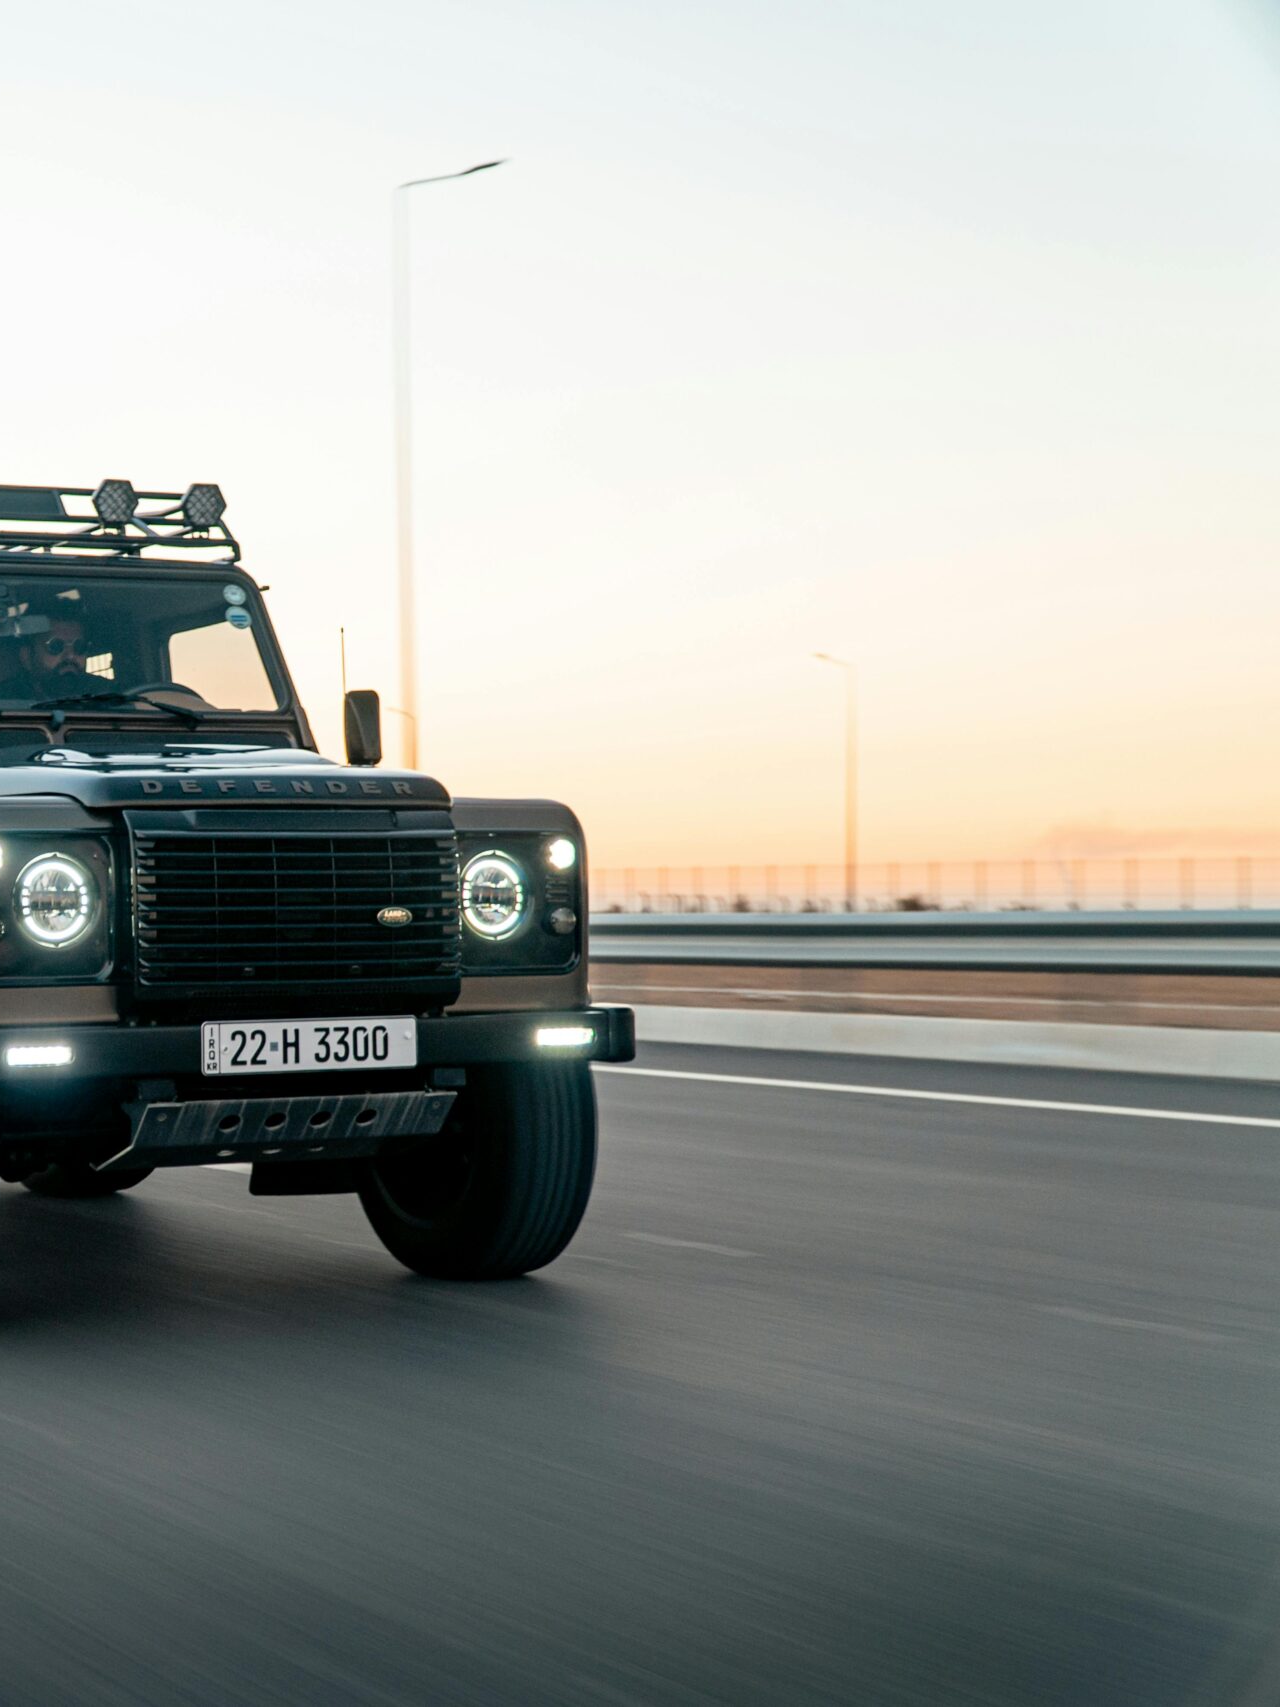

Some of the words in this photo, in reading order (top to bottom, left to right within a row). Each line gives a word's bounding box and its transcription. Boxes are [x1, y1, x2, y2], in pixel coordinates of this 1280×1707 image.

[140, 779, 413, 794] DEFENDER
[314, 1025, 389, 1063] 3300
[207, 1063, 218, 1071] KR
